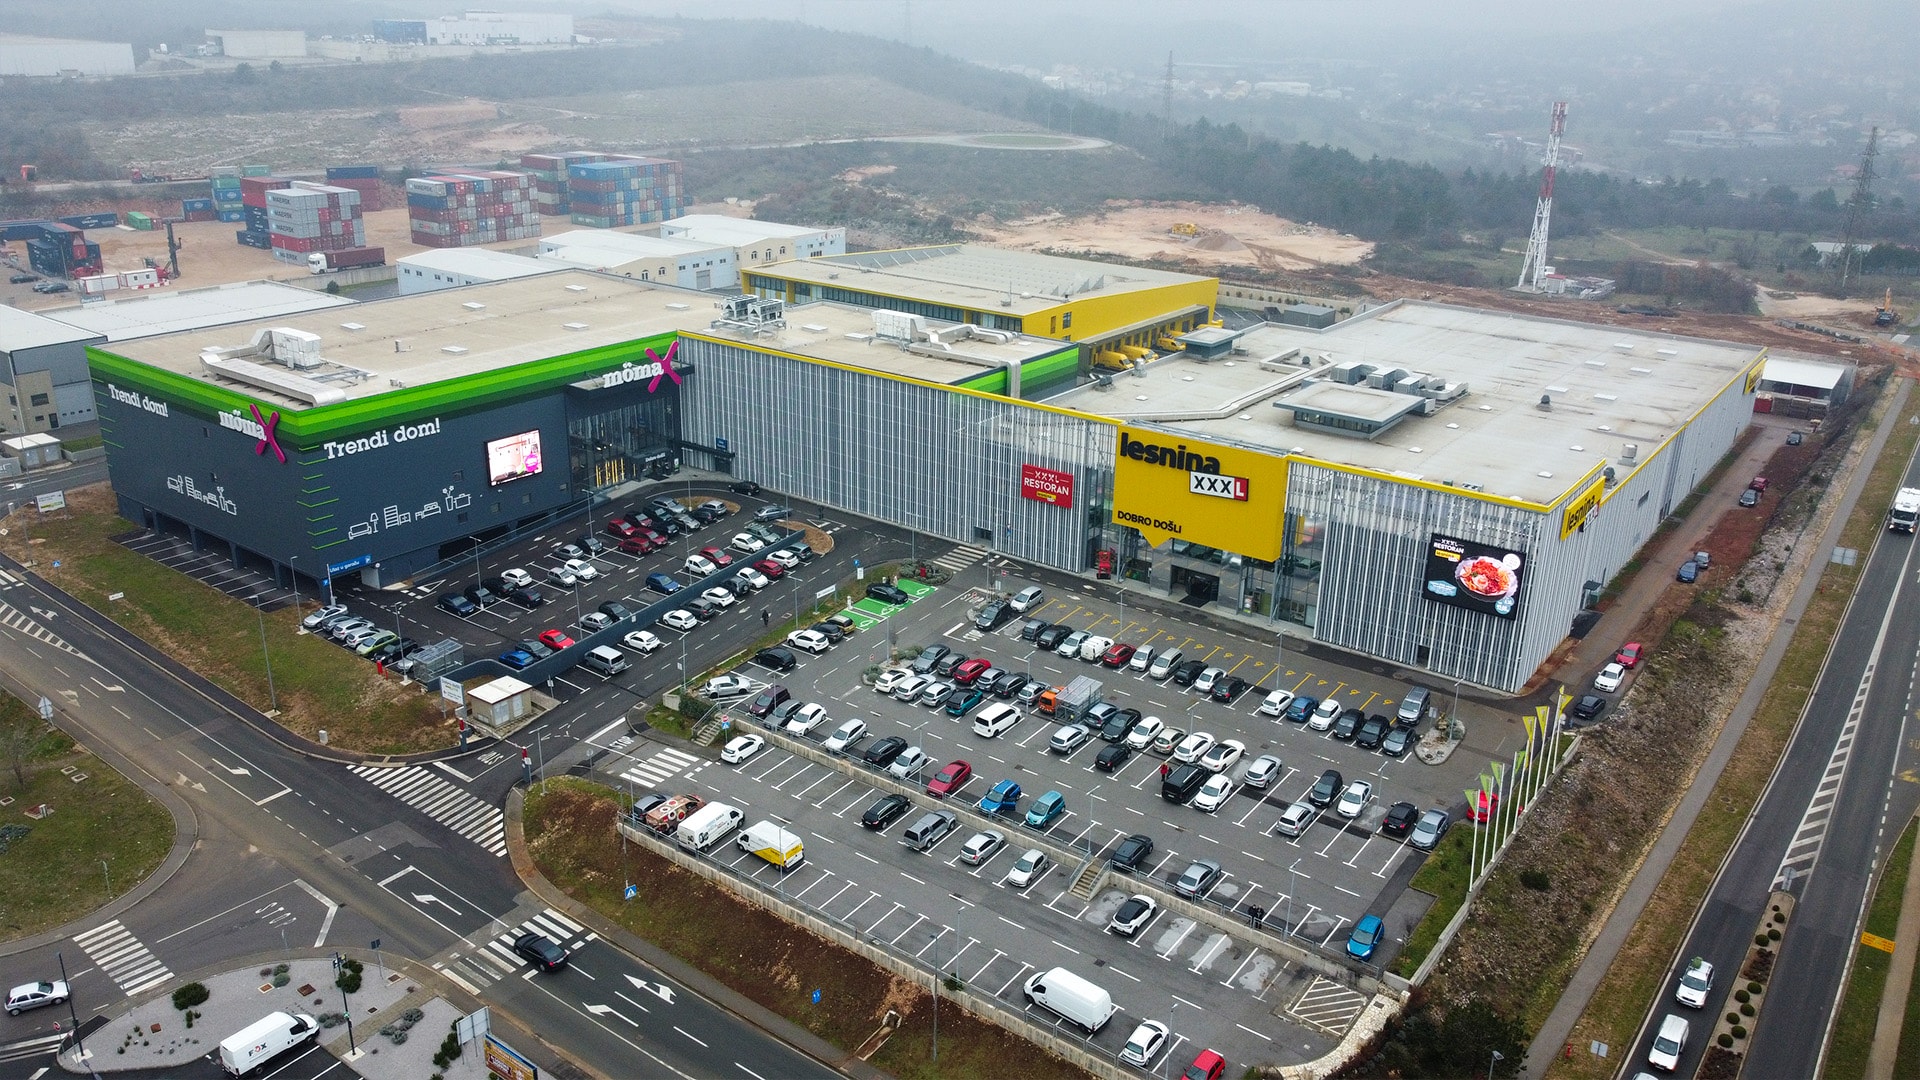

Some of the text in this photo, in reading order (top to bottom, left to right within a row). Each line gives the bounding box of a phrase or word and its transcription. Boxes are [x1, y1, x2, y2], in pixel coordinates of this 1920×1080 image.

[108, 384, 169, 418] Trendi dom!
[324, 417, 441, 459] Trendi dom!
[1120, 432, 1220, 476] lesnina
[1024, 477, 1070, 496] RESTORAN
[1035, 471, 1060, 483] XXXL
[1193, 475, 1245, 498] XXXL
[1117, 510, 1182, 534] DOBRO DOŠLI
[1433, 542, 1465, 554] RESTORAN
[255, 902, 297, 929] STOP
[248, 1042, 268, 1057] FOX
